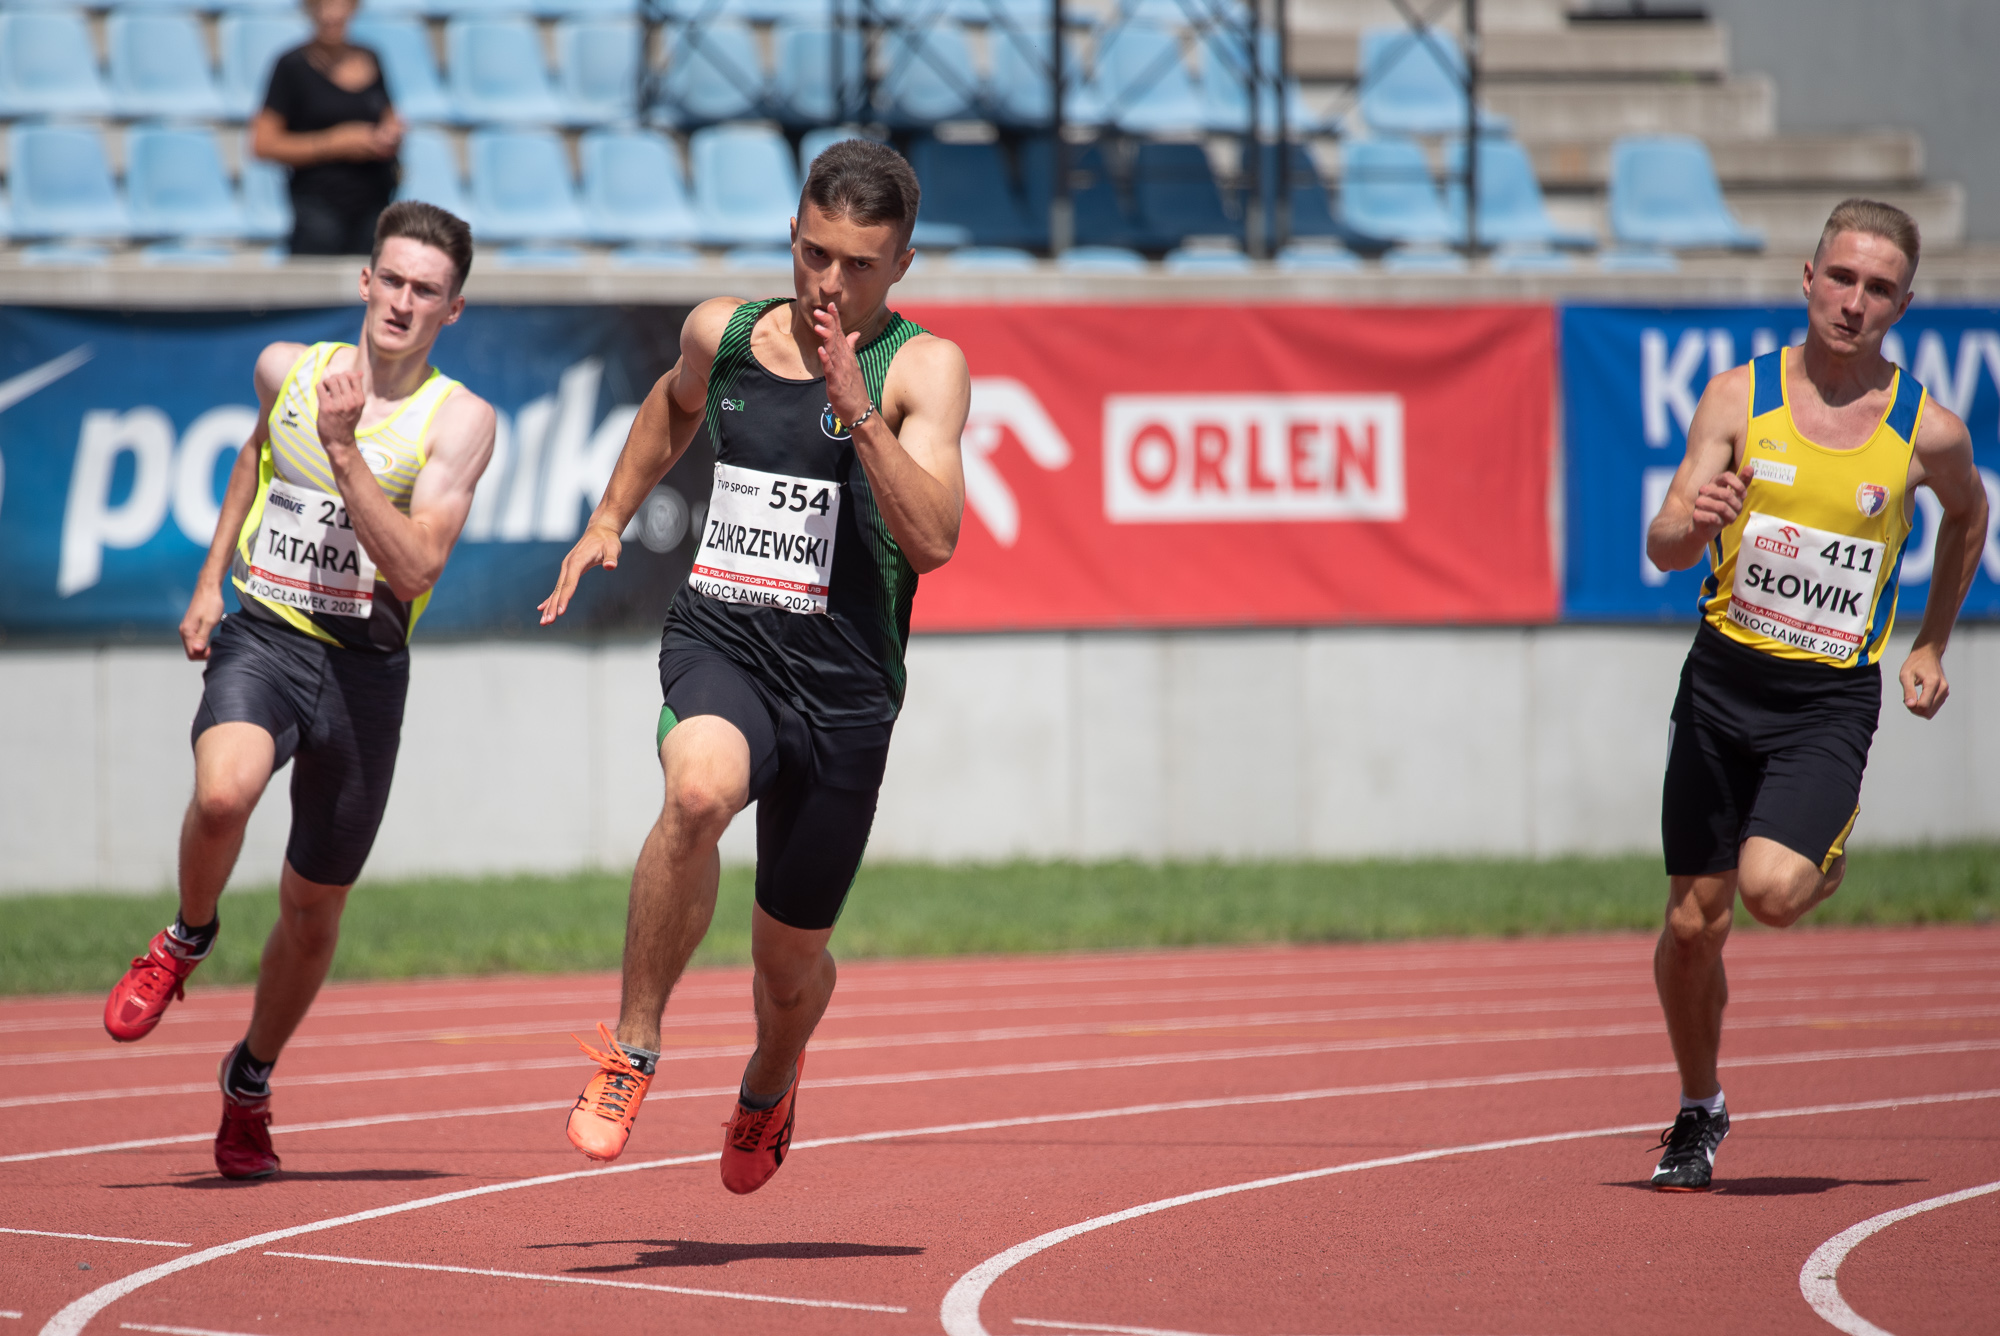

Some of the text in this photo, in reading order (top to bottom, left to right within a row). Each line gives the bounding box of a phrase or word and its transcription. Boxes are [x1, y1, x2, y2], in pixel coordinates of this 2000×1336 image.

[1129, 420, 1378, 494] ORLEN
[717, 480, 760, 496] TVP SPORT
[768, 480, 830, 516] 554
[269, 529, 360, 576] TATARA
[706, 519, 829, 568] ZAKRZEWSKI
[1757, 538, 1797, 558] ORLEN
[1820, 540, 1875, 574] 411
[695, 579, 817, 612] WŁOCŁAWEK 2021
[710, 569, 724, 578] PZLA
[778, 581, 806, 592] POLSKI
[1744, 563, 1864, 618] SŁOWIK
[331, 600, 362, 614] 2021
[1734, 608, 1853, 658] WŁOCŁAWEK 2021
